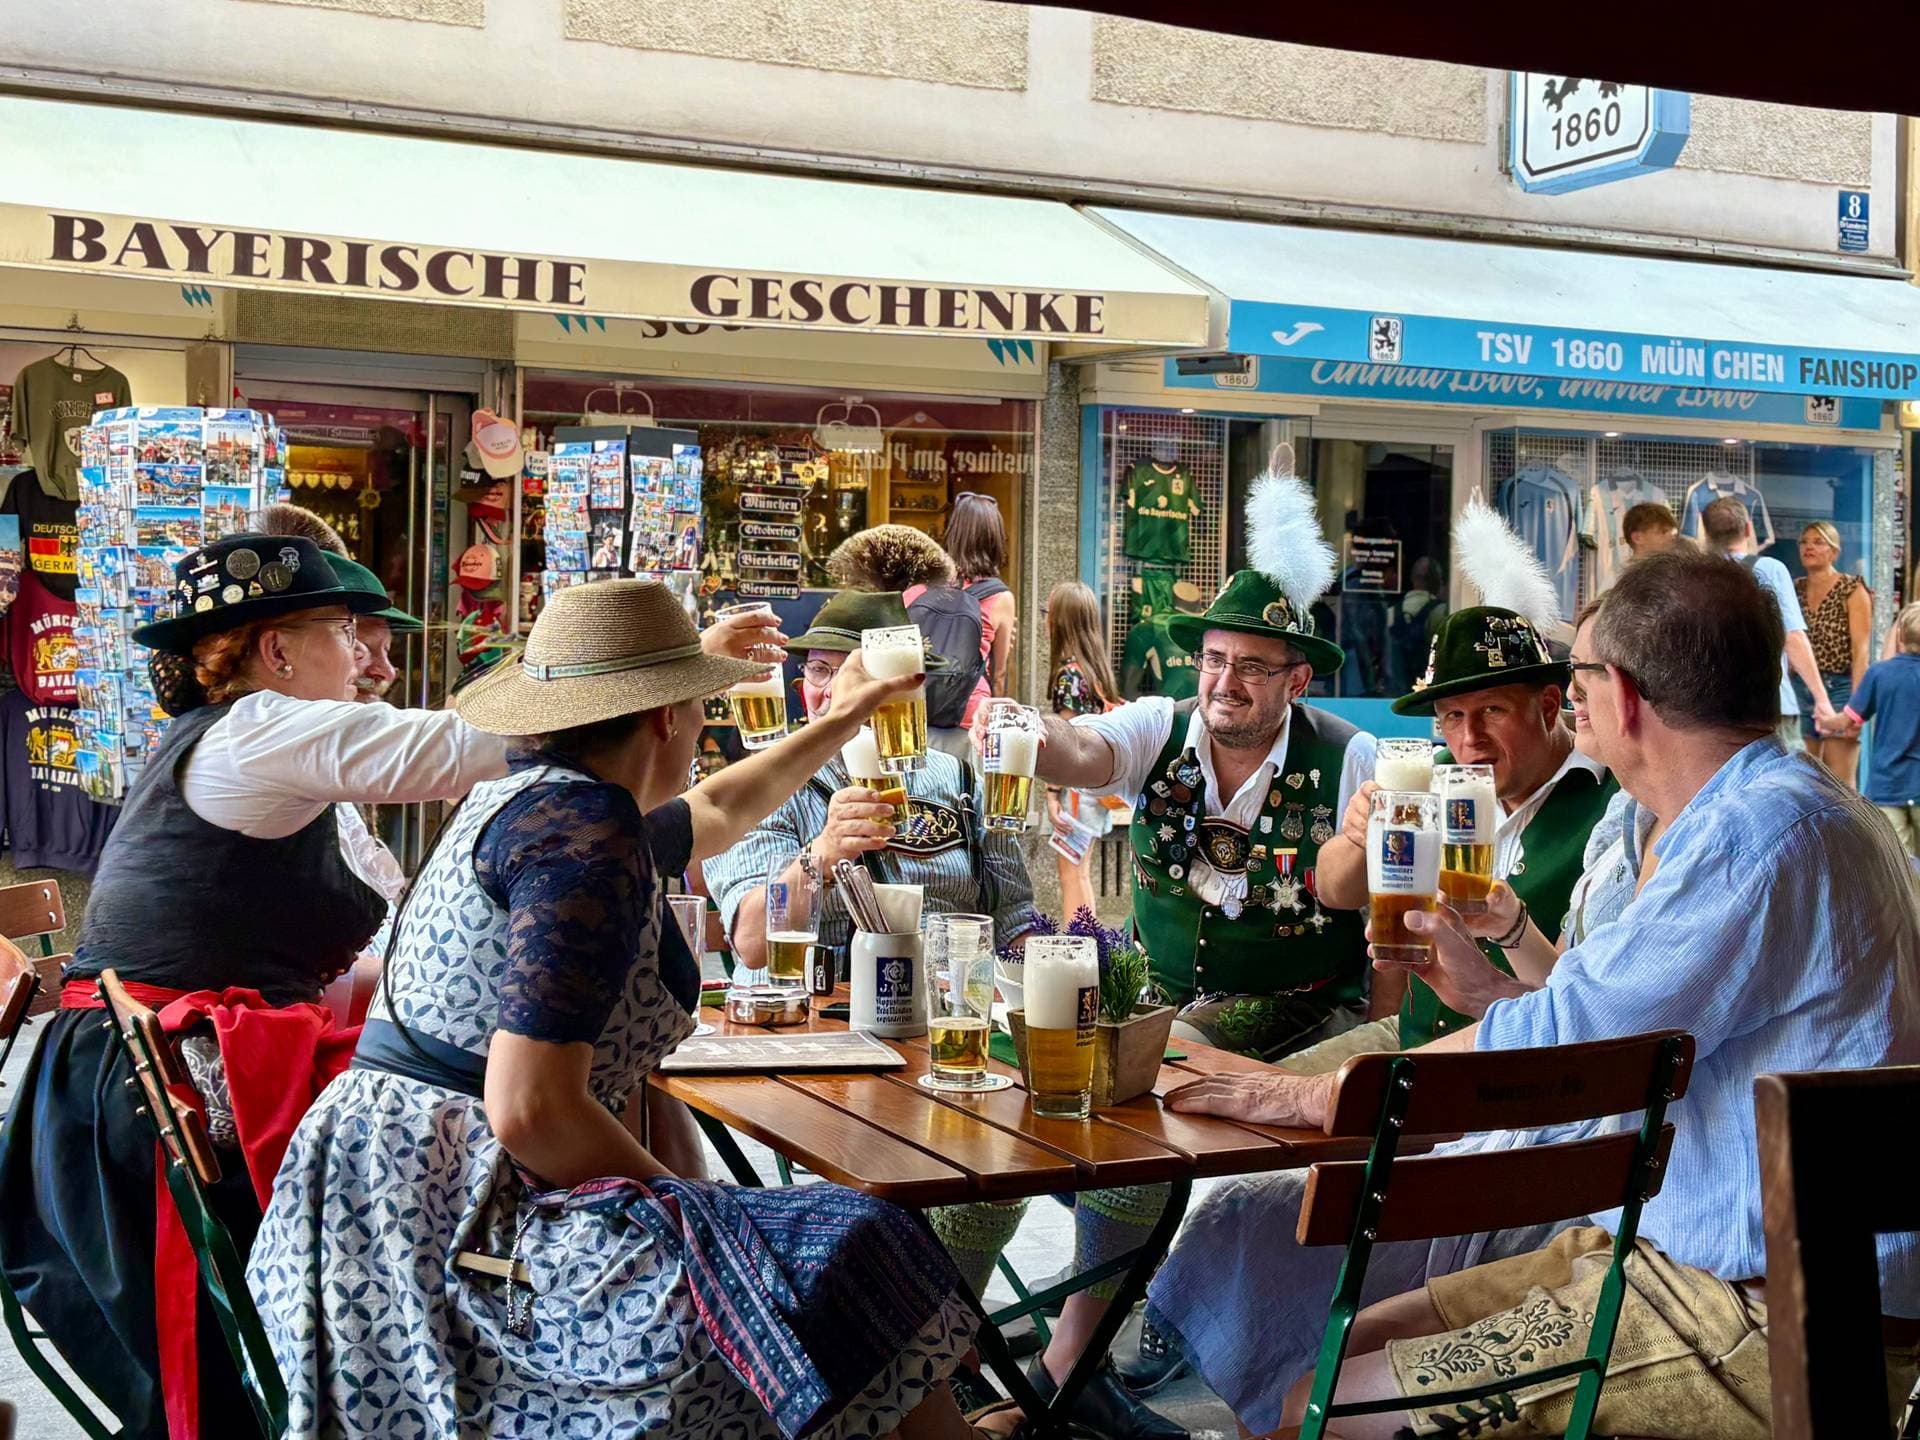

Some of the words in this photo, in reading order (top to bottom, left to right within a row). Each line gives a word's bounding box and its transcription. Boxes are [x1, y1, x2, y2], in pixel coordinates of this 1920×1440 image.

[1551, 102, 1621, 151] 1860
[1848, 194, 1861, 218] 8
[46, 213, 587, 306] BAYERISCHE
[690, 273, 1105, 335] GESCHENKE
[1476, 331, 1533, 365] TSV
[1551, 337, 1624, 372] 1860
[1799, 357, 1918, 391] FANSHOP
[1224, 375, 1249, 385] 1860
[744, 495, 799, 511] München
[744, 524, 796, 537] Oktoberfest
[34, 559, 78, 571] GERM
[741, 554, 799, 566] Bierkeller
[740, 582, 798, 597] Biergarten
